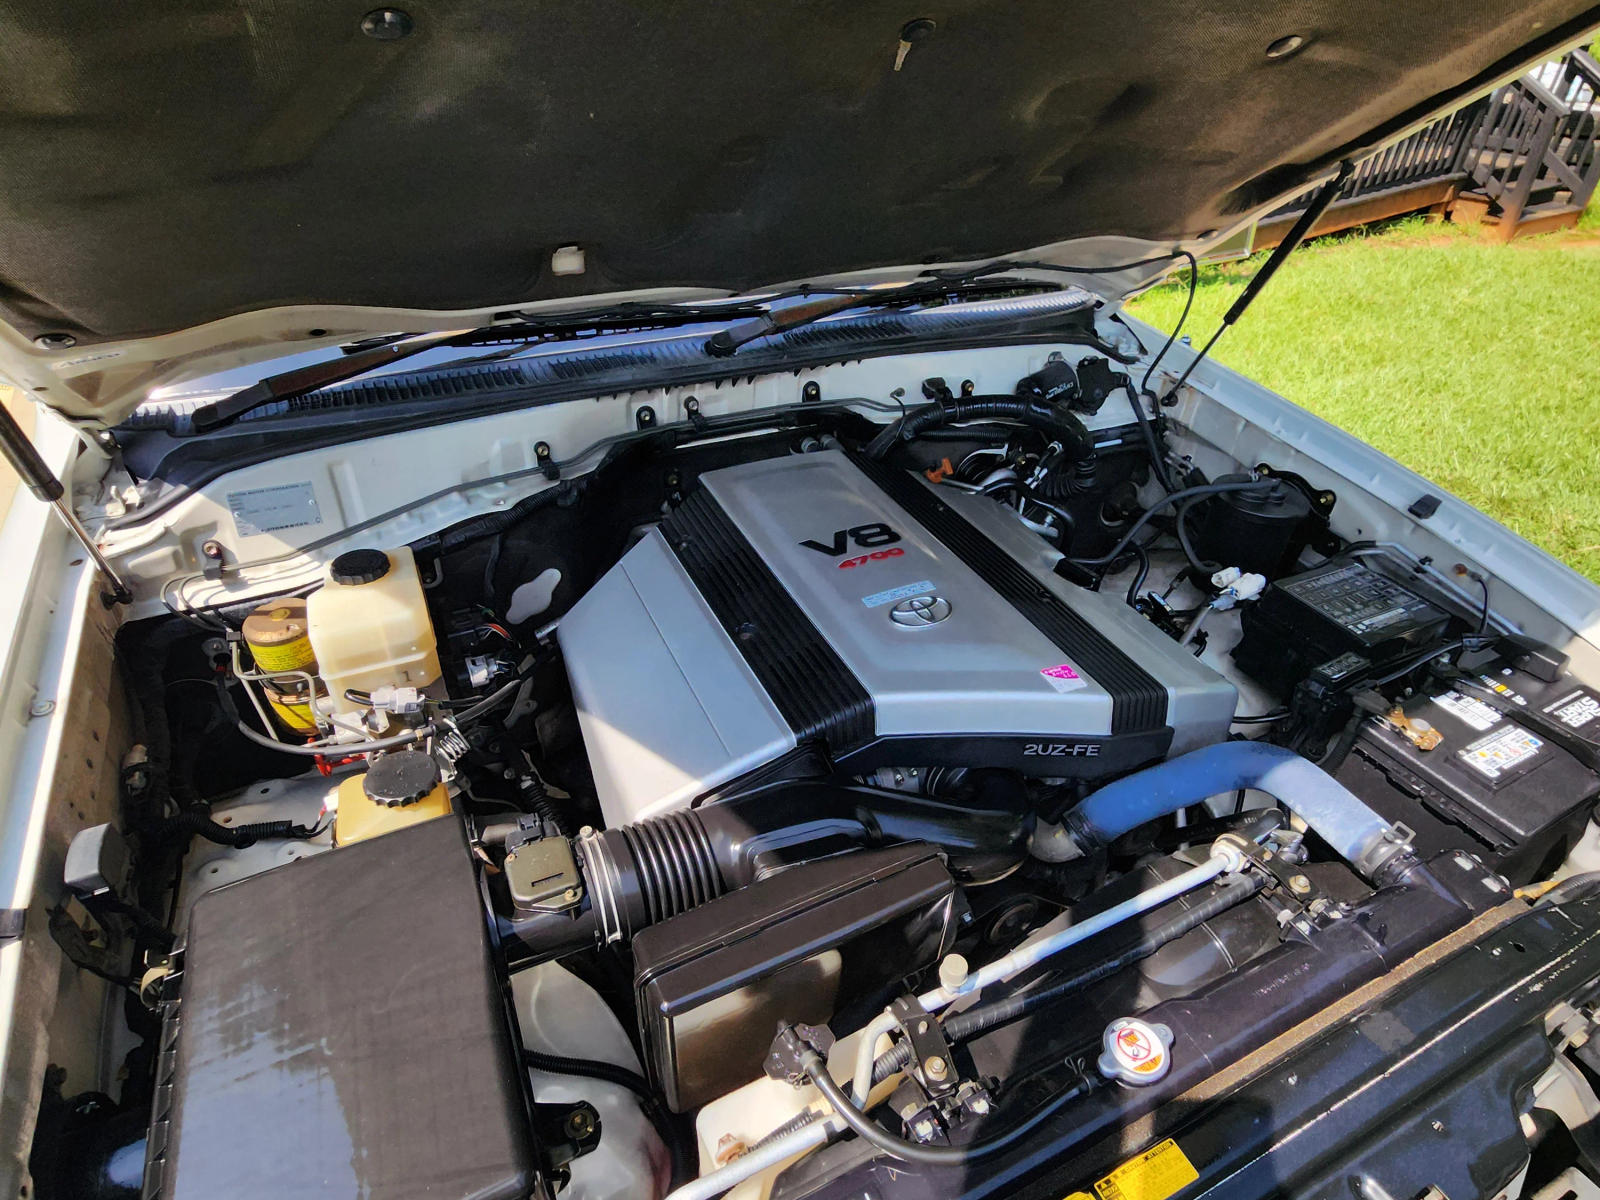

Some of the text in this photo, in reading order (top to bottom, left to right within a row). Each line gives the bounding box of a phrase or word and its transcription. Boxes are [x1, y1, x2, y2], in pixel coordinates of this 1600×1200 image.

[798, 522, 902, 557] V8
[838, 547, 905, 569] 4700
[1023, 744, 1101, 756] 2UZ-FE
